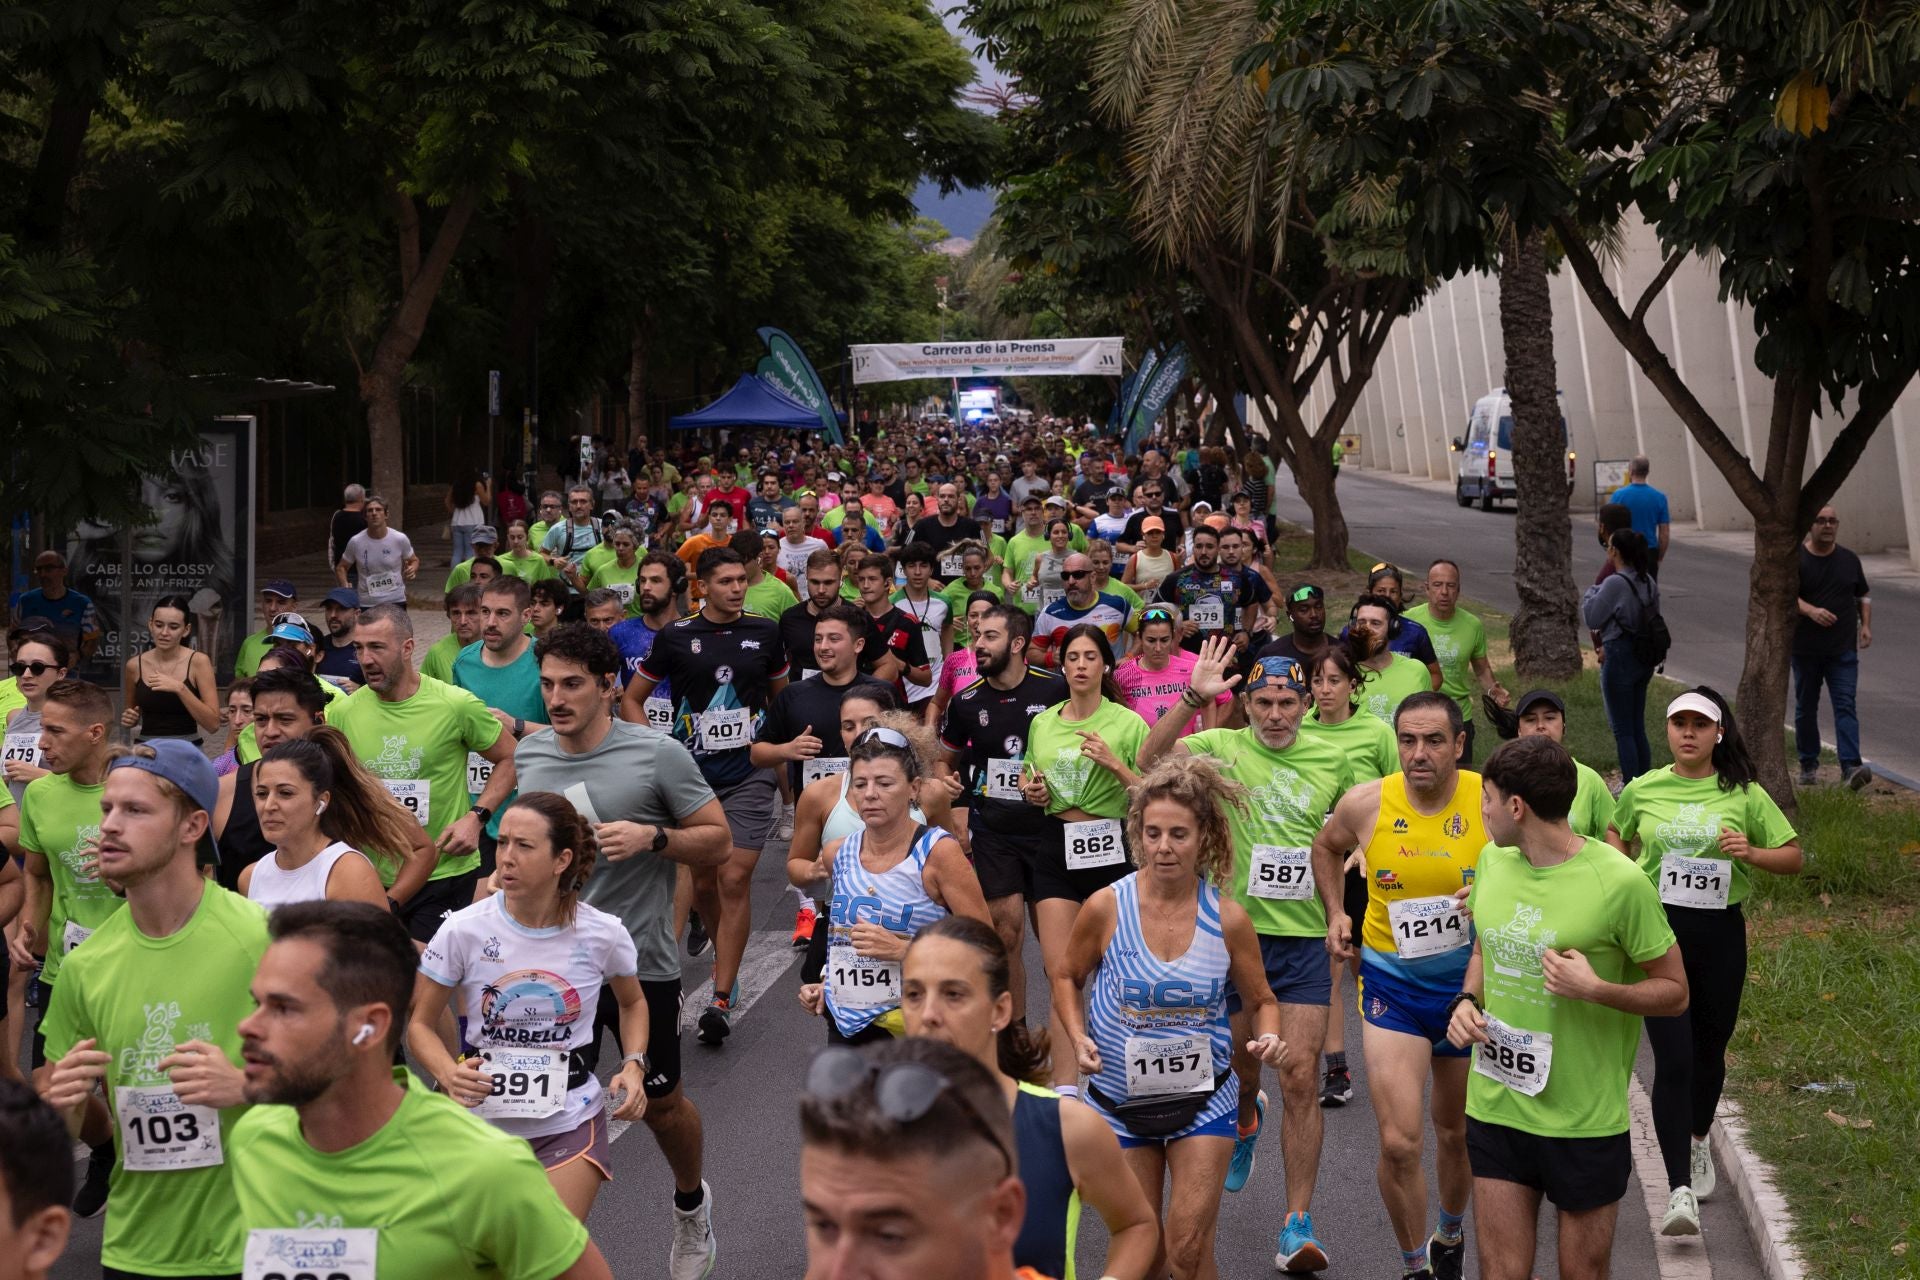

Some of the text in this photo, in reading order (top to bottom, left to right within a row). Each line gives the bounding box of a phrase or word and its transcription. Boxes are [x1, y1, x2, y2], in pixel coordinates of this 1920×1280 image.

[922, 342, 1055, 356] Carrera de la Prensa
[86, 563, 215, 575] CABELO GLOSSY
[95, 578, 103, 588] 4
[136, 578, 203, 588] ANTI-FRIZZ
[1194, 612, 1218, 622] 379
[1155, 681, 1188, 695] MEDULA
[708, 722, 744, 739] 407
[5, 748, 34, 763] 479
[1073, 835, 1115, 855] 862
[1259, 863, 1307, 884] 587
[1667, 871, 1721, 891] 1131
[1375, 880, 1404, 892] Vopak
[1399, 914, 1461, 939] 1214
[1118, 948, 1140, 959] vive
[835, 967, 892, 987] 1154
[1118, 978, 1220, 1008] RCJ
[1121, 1019, 1153, 1030] RUNNING
[1155, 1020, 1189, 1028] CIUDAD
[481, 1026, 573, 1044] MARBELLA
[1133, 1052, 1201, 1076] 1157
[1484, 1038, 1536, 1075] 586
[490, 1072, 550, 1098] 891
[129, 1112, 200, 1146] 103
